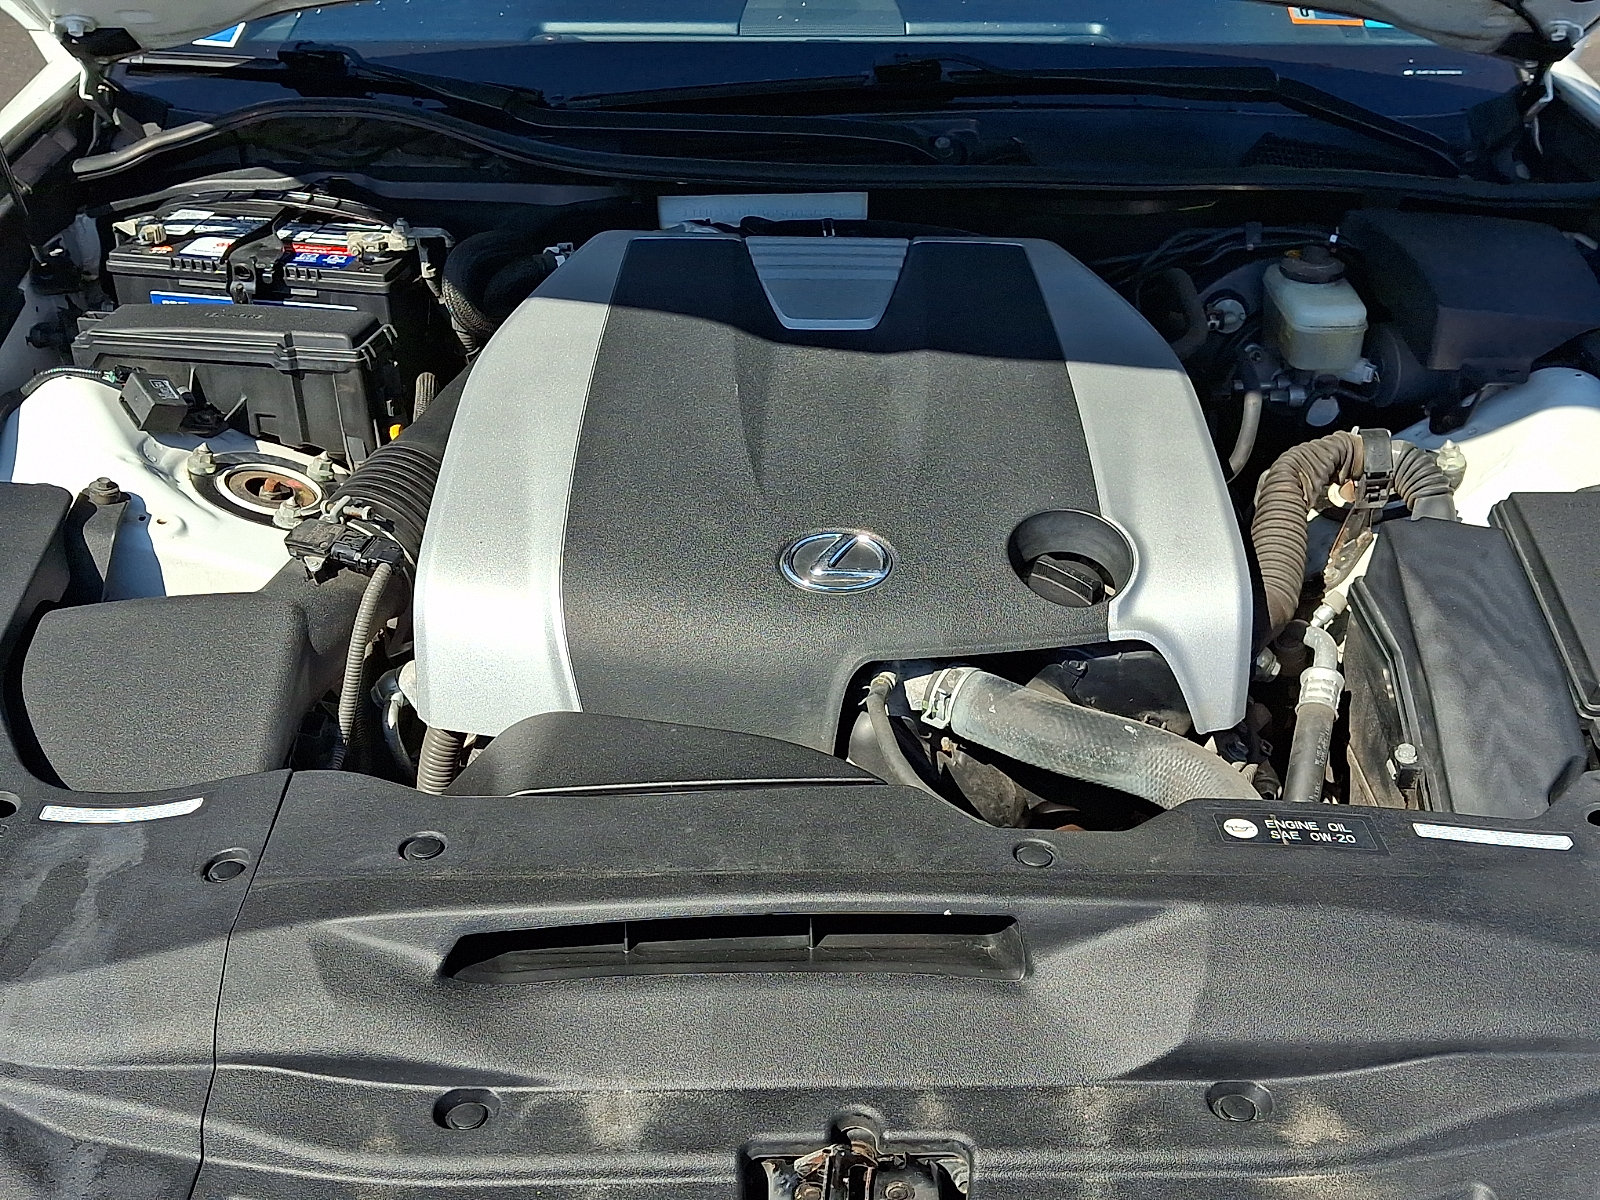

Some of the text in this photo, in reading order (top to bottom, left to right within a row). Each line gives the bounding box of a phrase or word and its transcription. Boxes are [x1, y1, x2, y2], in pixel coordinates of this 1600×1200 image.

[1264, 819, 1352, 833] ENGINE OIL
[1270, 830, 1357, 844] SAE 0W-20
